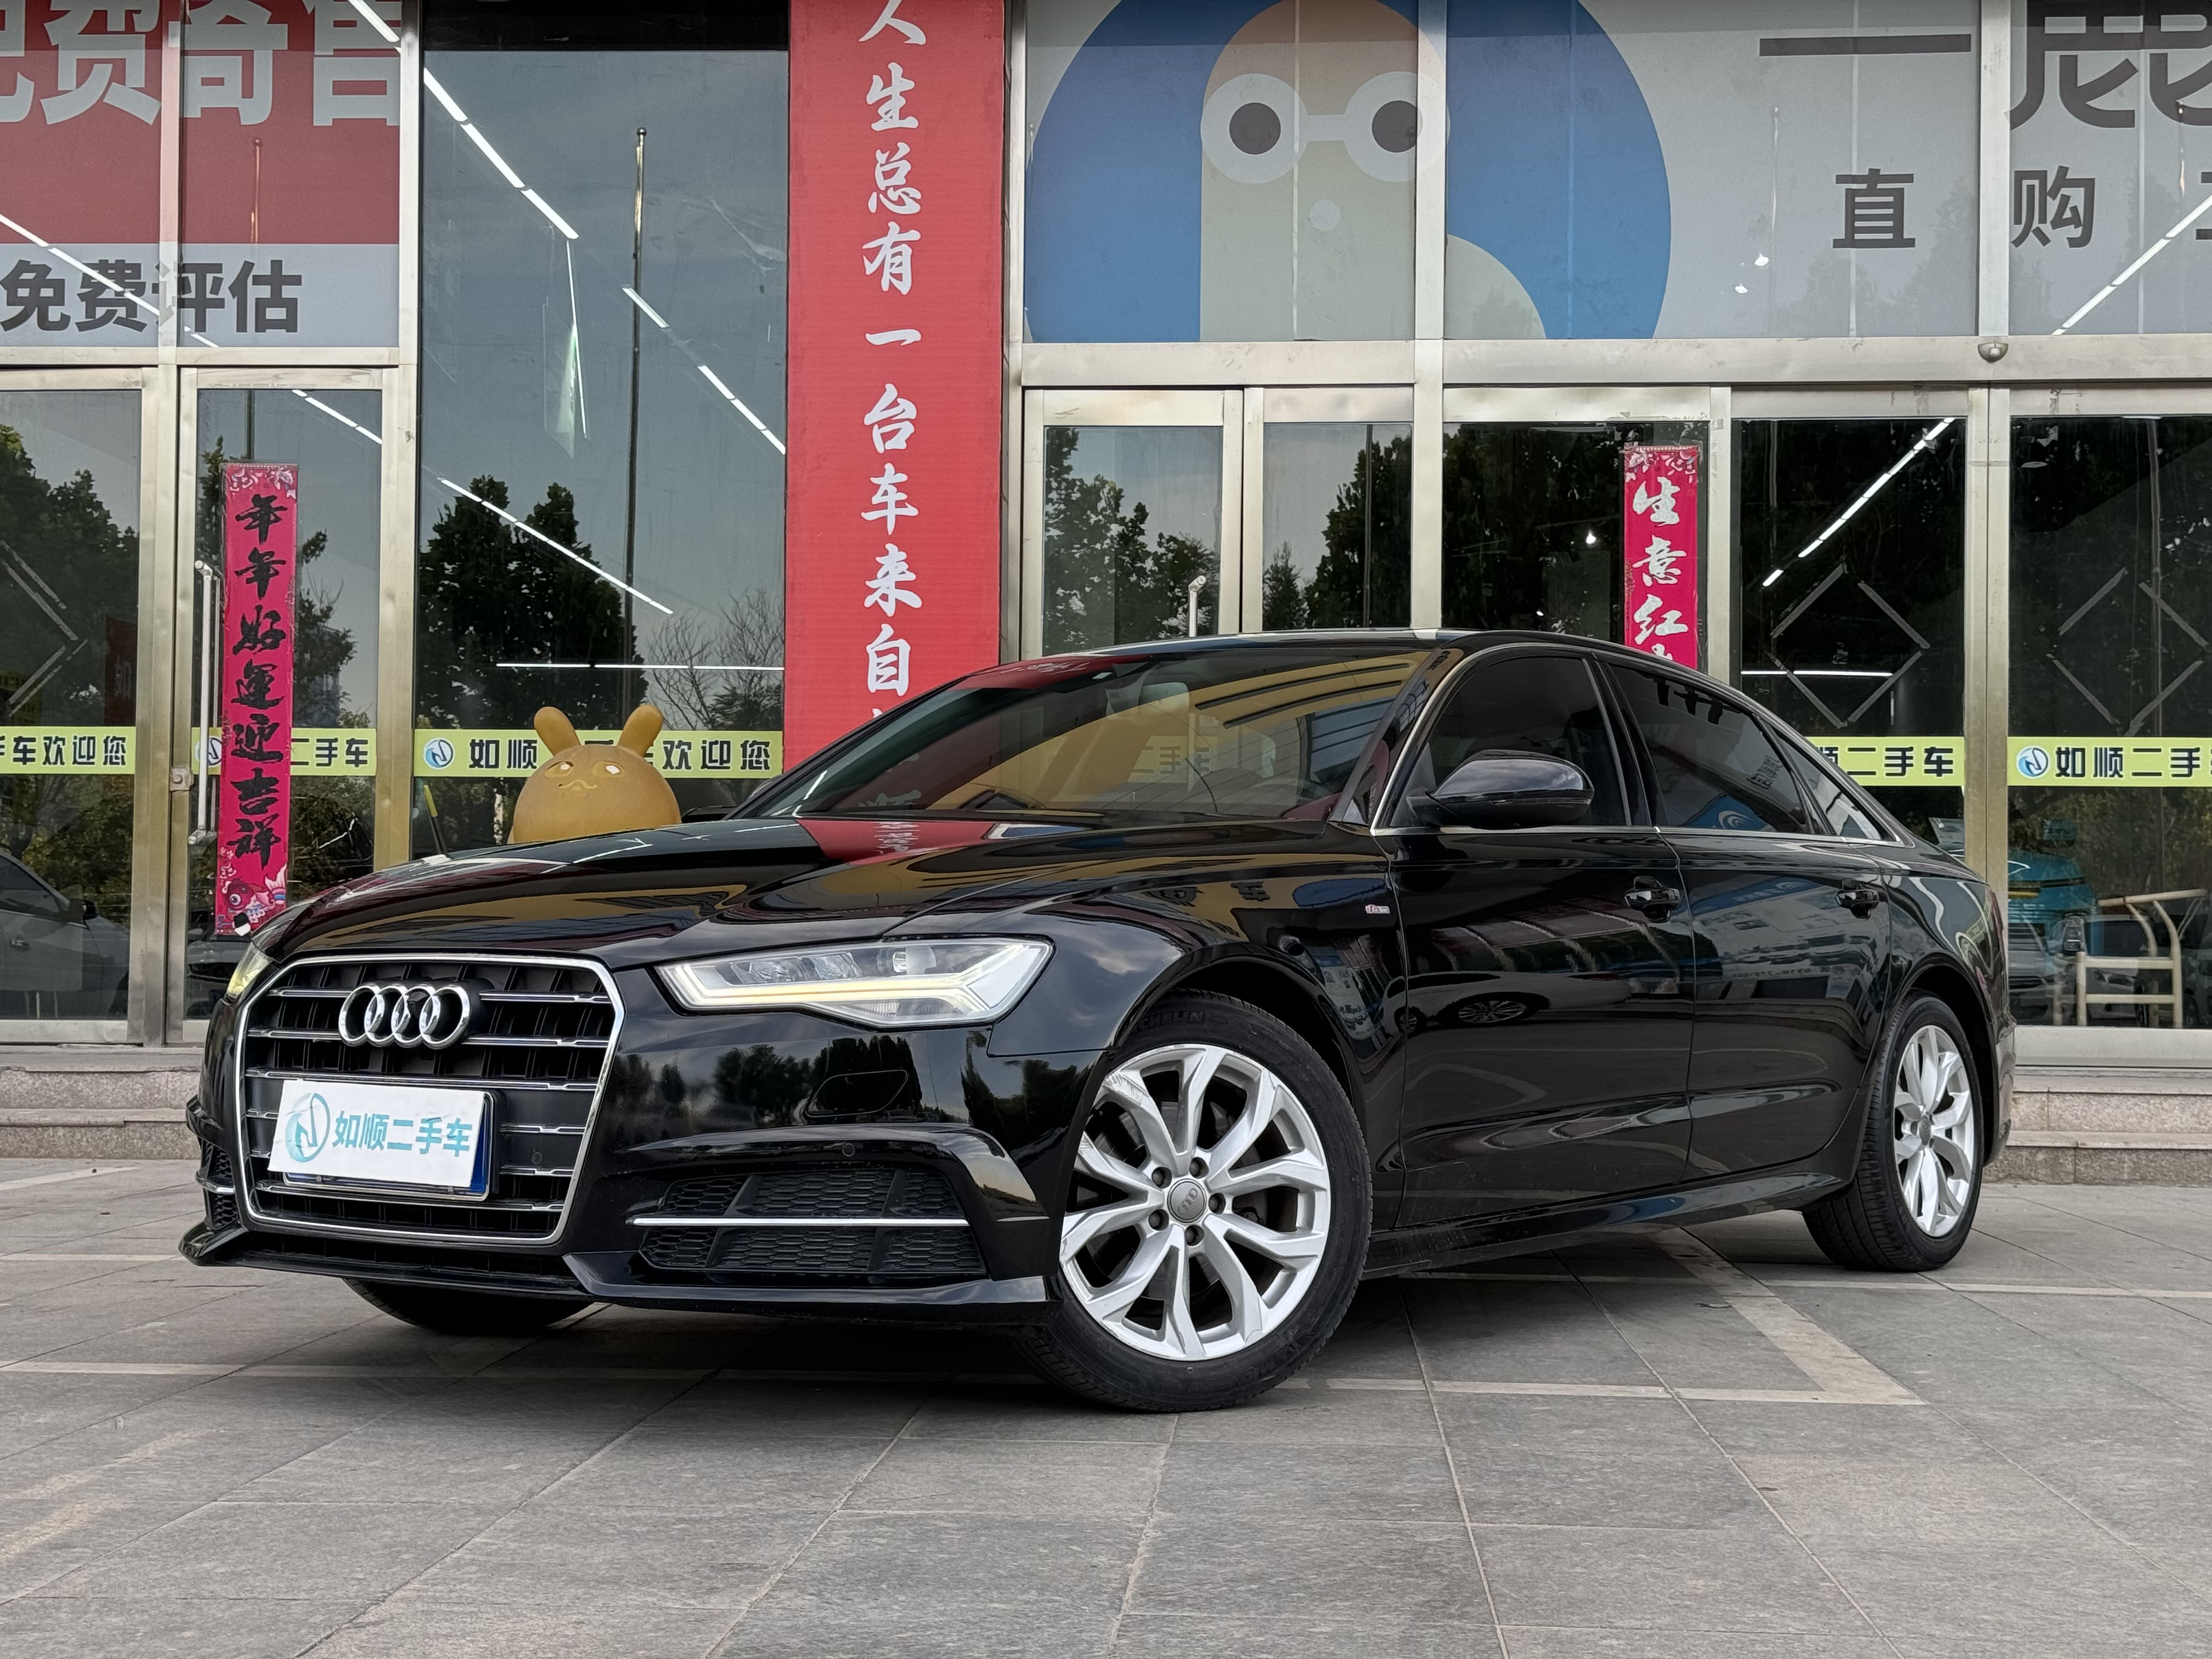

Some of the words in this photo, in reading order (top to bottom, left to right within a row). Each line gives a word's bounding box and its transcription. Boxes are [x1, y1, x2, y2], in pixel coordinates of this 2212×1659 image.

[1832, 166, 2212, 249] 直购
[0, 259, 302, 332] 免费评估
[858, 0, 926, 718] 人生总有一台车来自
[1632, 476, 1689, 661] 生意红
[0, 736, 126, 765] 车欢迎您
[469, 738, 771, 771] 如顺欢迎您
[2055, 746, 2212, 778] 如顺二手
[332, 1110, 475, 1158] 如顺二手车
